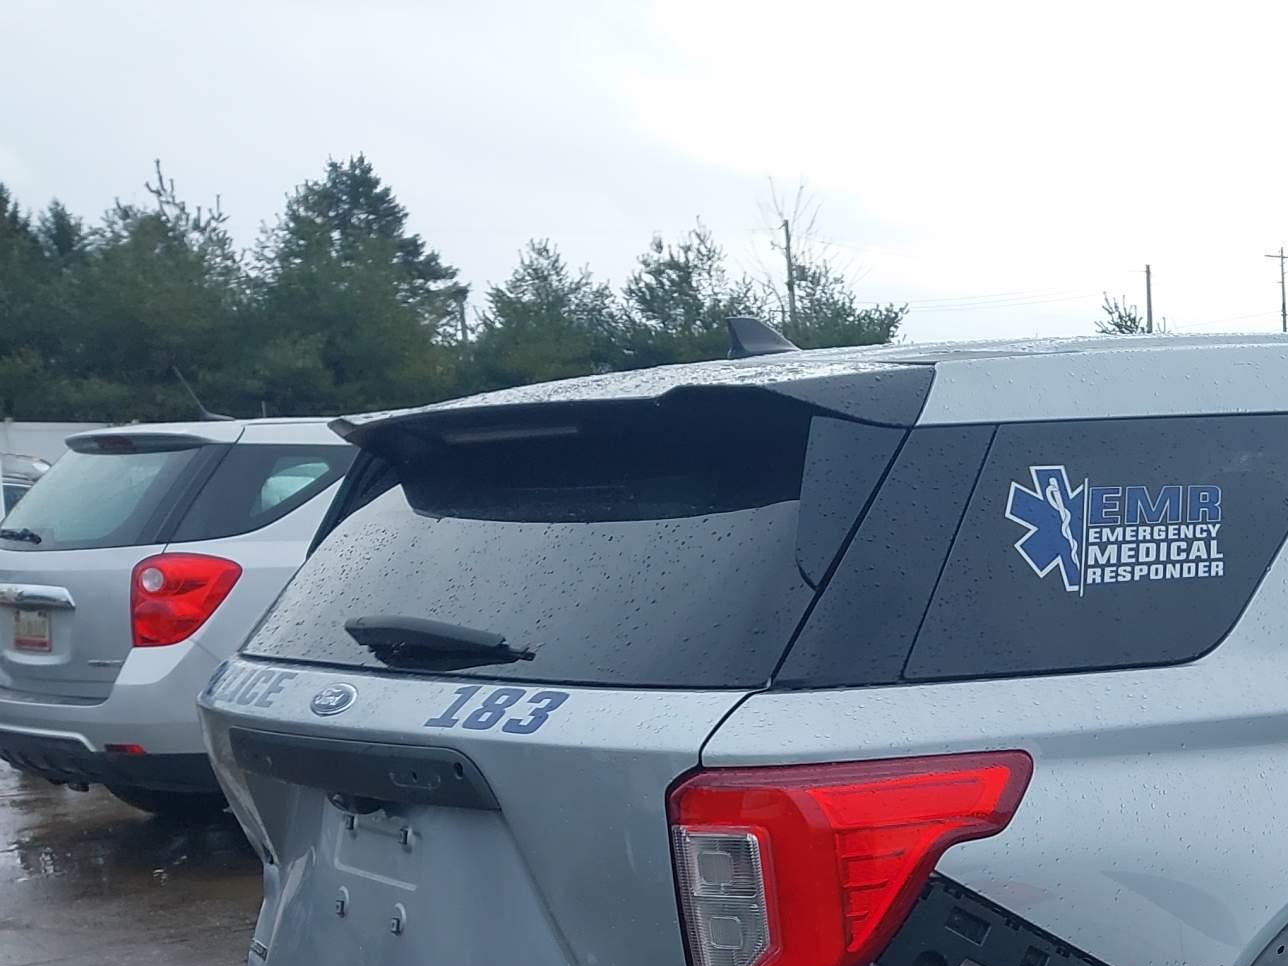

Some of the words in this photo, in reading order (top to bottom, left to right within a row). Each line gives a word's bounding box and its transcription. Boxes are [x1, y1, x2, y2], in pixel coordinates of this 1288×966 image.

[1087, 484, 1222, 526] EMR
[1087, 523, 1222, 543] EMERGENCY
[1087, 540, 1224, 565] MEDICAL
[1086, 561, 1224, 585] RESPONDER
[424, 685, 570, 735] 183
